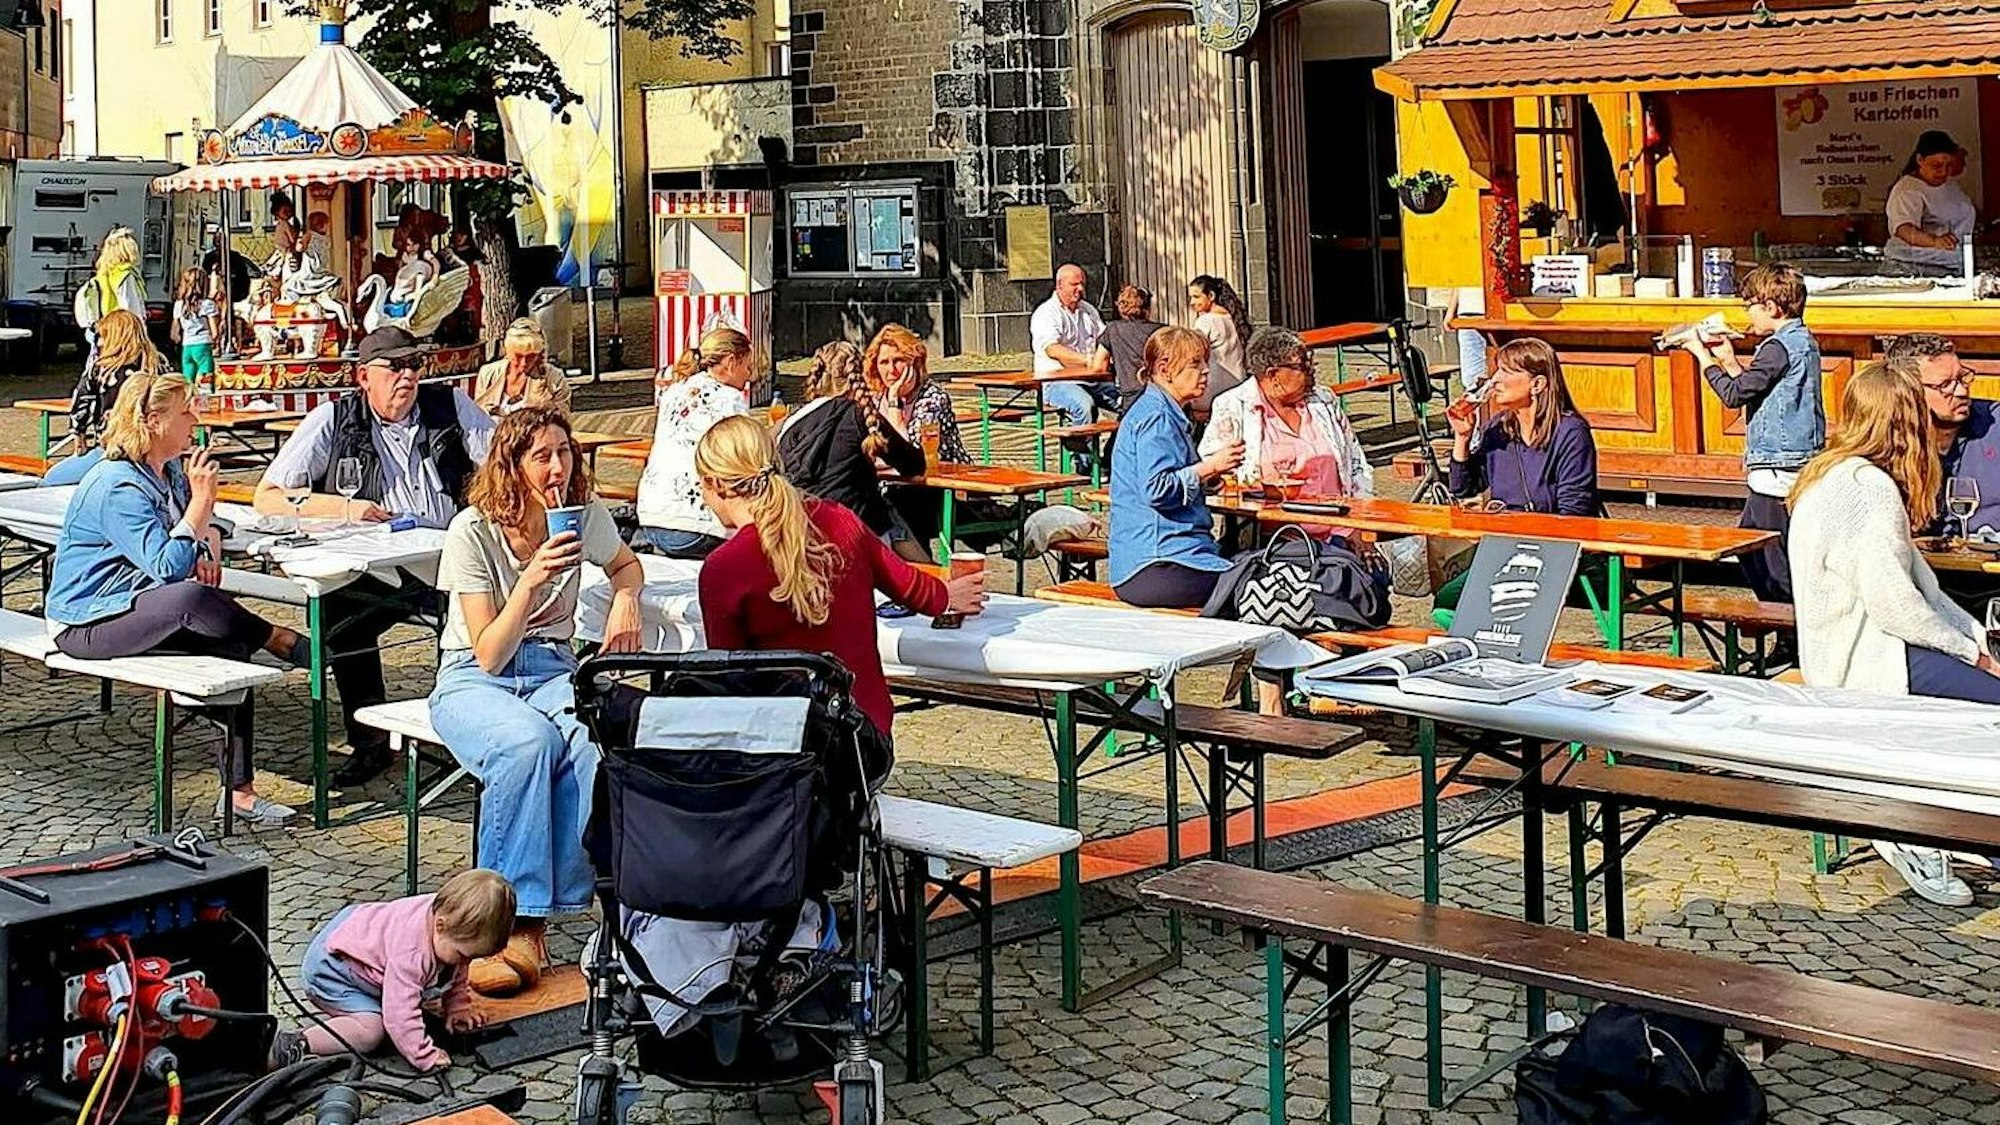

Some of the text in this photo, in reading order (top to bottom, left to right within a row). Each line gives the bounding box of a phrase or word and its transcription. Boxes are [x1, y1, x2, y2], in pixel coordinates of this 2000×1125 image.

[1848, 85, 1959, 103] aus Frischen
[1854, 105, 1939, 122] Kartoffeln
[1801, 155, 1824, 165] nach
[1817, 173, 1868, 186] 3 Stück
